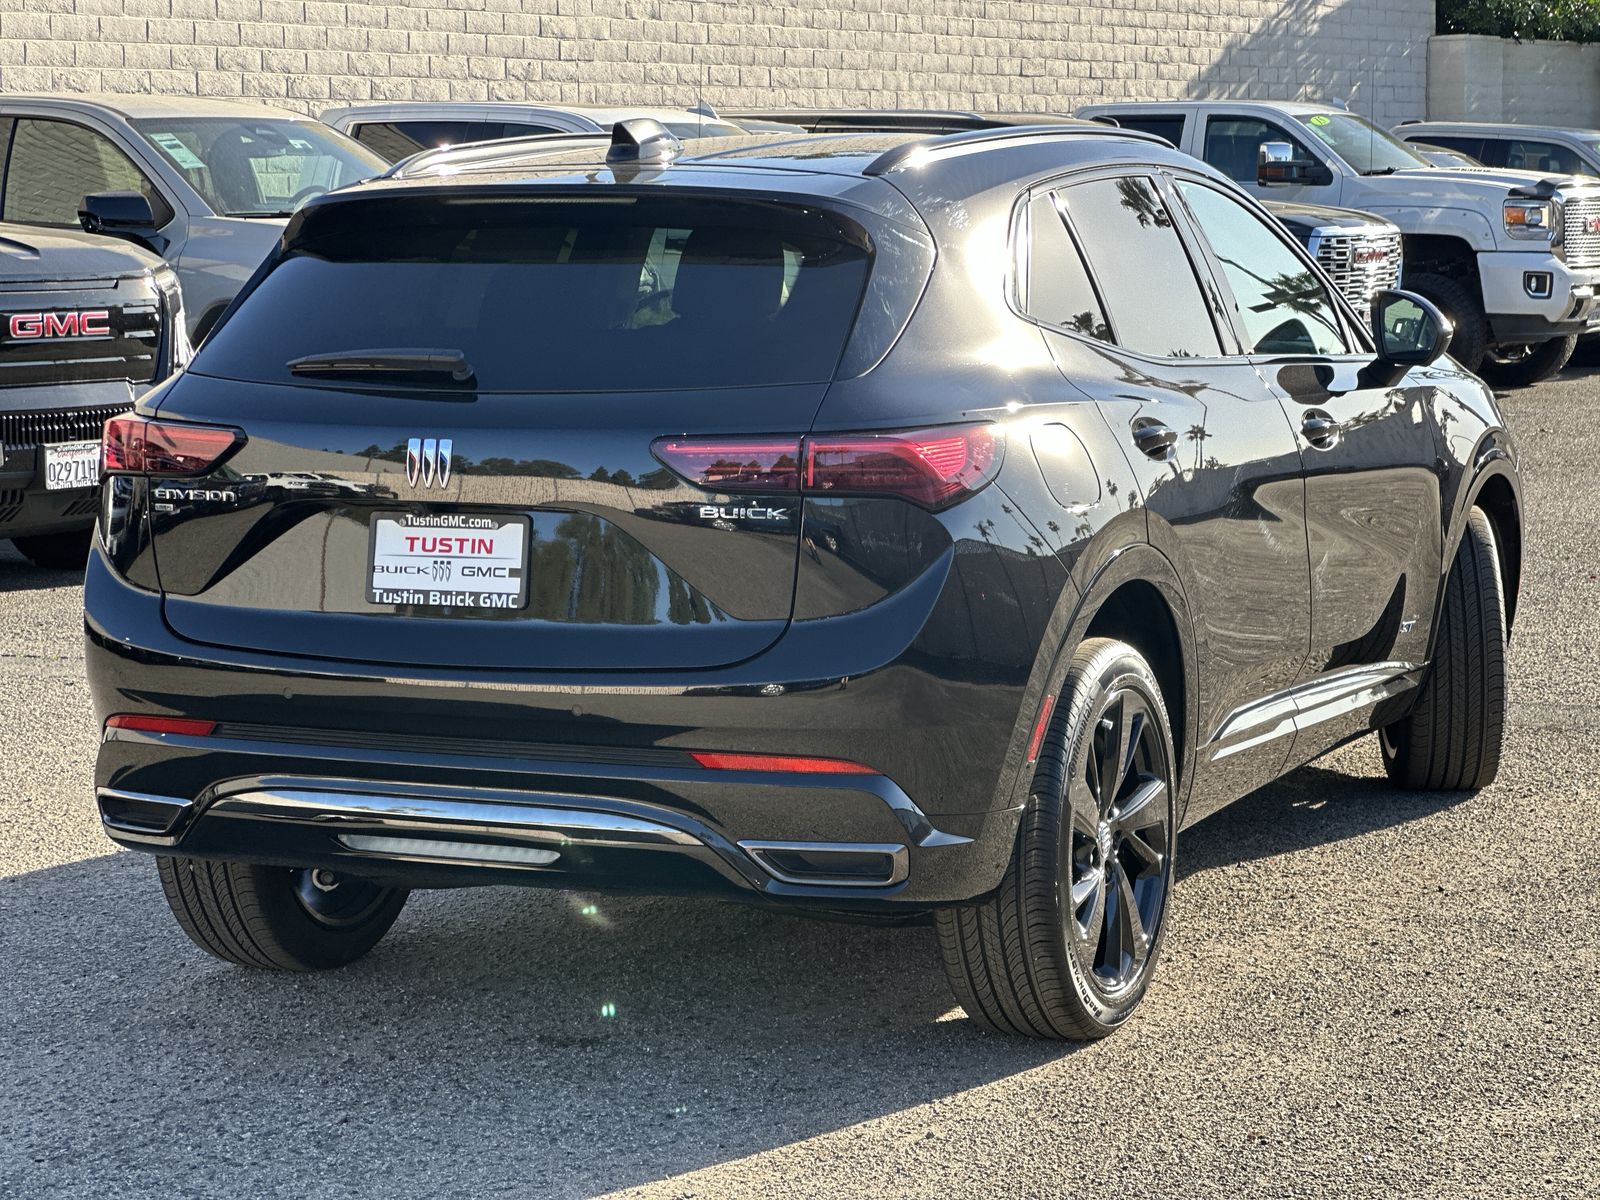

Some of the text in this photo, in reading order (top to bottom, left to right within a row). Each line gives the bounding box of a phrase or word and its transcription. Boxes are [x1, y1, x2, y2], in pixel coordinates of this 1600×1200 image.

[10, 311, 110, 339] GMC
[155, 488, 236, 502] ENVISION
[699, 506, 789, 520] BUICK
[406, 514, 492, 529] TustinGMC.com
[405, 536, 494, 554] TUSTIN
[374, 564, 507, 578] BUICK GMC
[373, 589, 518, 609] Tustin Buick GMC
[1067, 701, 1093, 779] Continental
